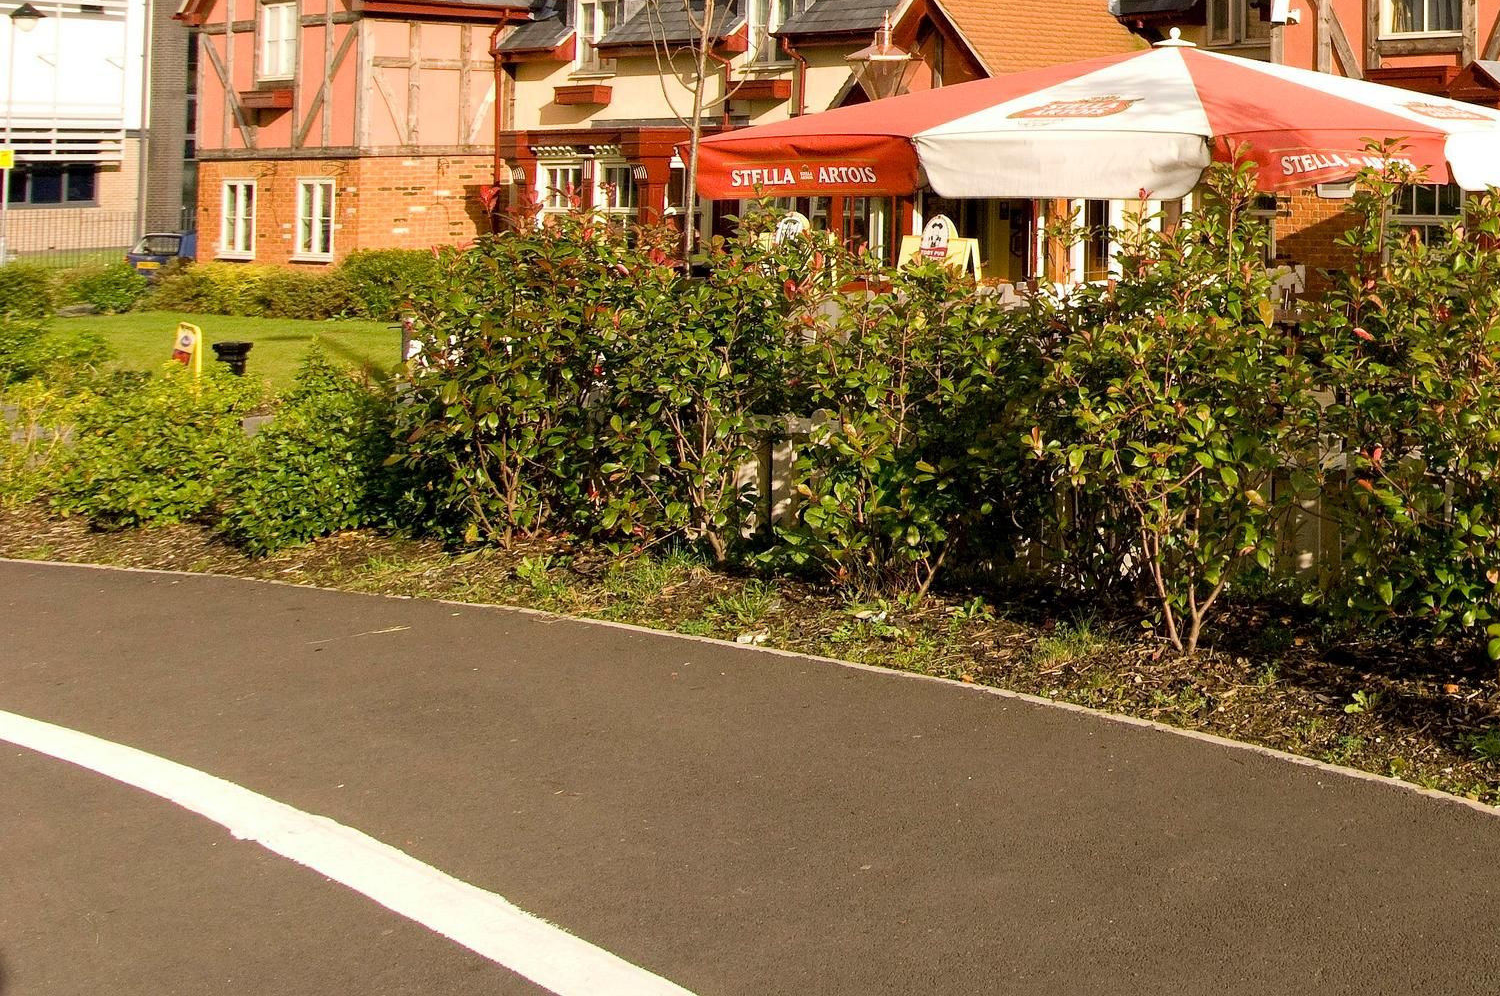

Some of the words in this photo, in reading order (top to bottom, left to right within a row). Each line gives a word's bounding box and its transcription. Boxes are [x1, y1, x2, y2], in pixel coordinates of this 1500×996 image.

[1281, 153, 1349, 175] STELLA
[731, 167, 796, 187] STELLA
[818, 166, 877, 183] ARTOIS
